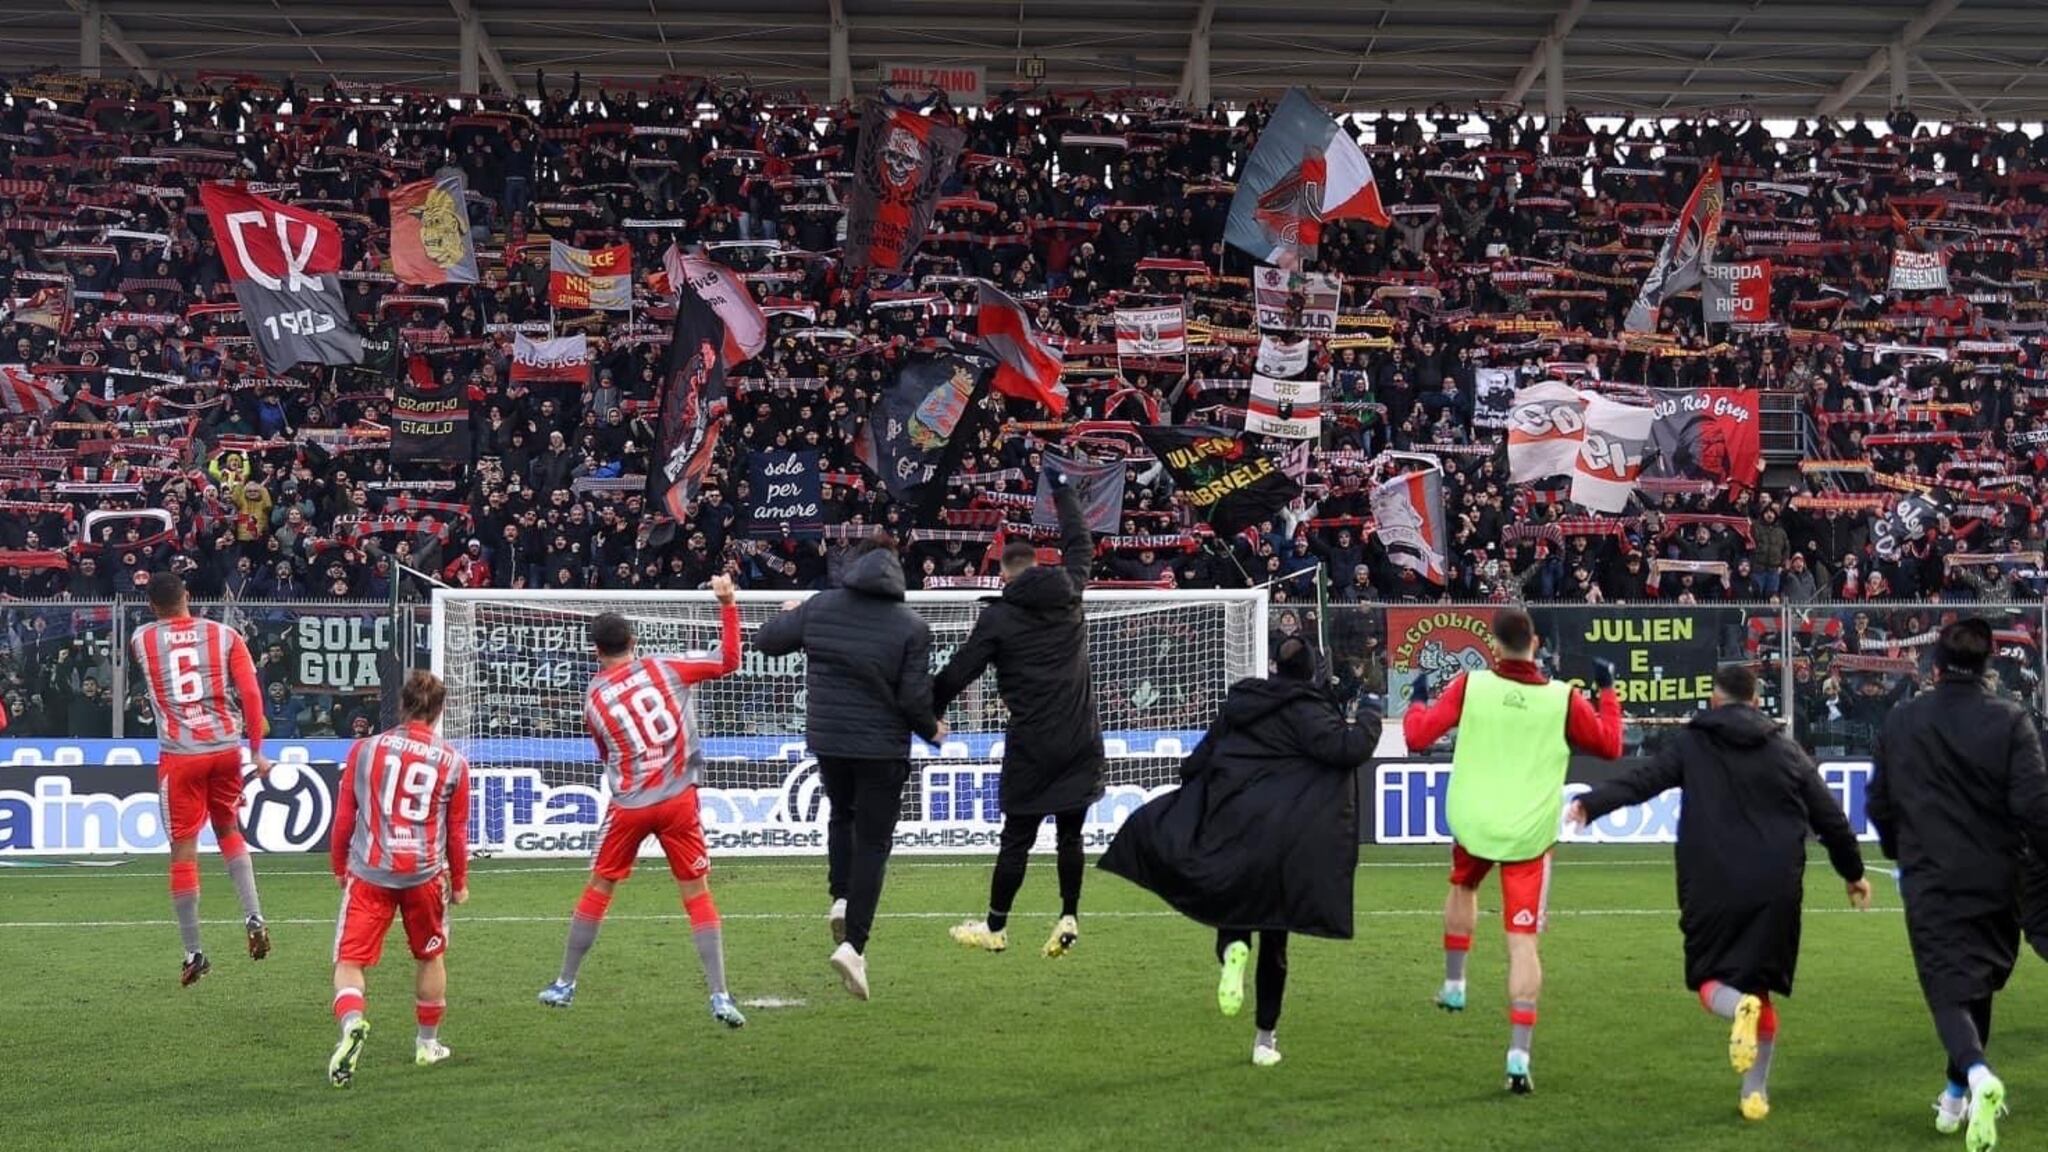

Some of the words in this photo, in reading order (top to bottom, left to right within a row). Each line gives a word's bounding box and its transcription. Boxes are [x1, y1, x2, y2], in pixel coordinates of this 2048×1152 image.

[1709, 264, 1763, 280] BRODA
[1729, 282, 1739, 296] E
[1716, 298, 1754, 312] RIPO
[1653, 399, 1677, 420] Old
[1681, 394, 1711, 411] Red
[1714, 397, 1749, 423] Grey
[401, 421, 452, 434] GIALLO
[764, 453, 804, 476] solo
[766, 483, 802, 503] per
[754, 503, 817, 519] amore
[1584, 618, 1693, 642] JULIEN
[301, 652, 381, 686] GUA
[1630, 650, 1649, 672] E
[170, 648, 204, 702] 6
[1568, 675, 1713, 703] GBRIELE
[610, 686, 679, 753] 18
[383, 754, 438, 820] 19
